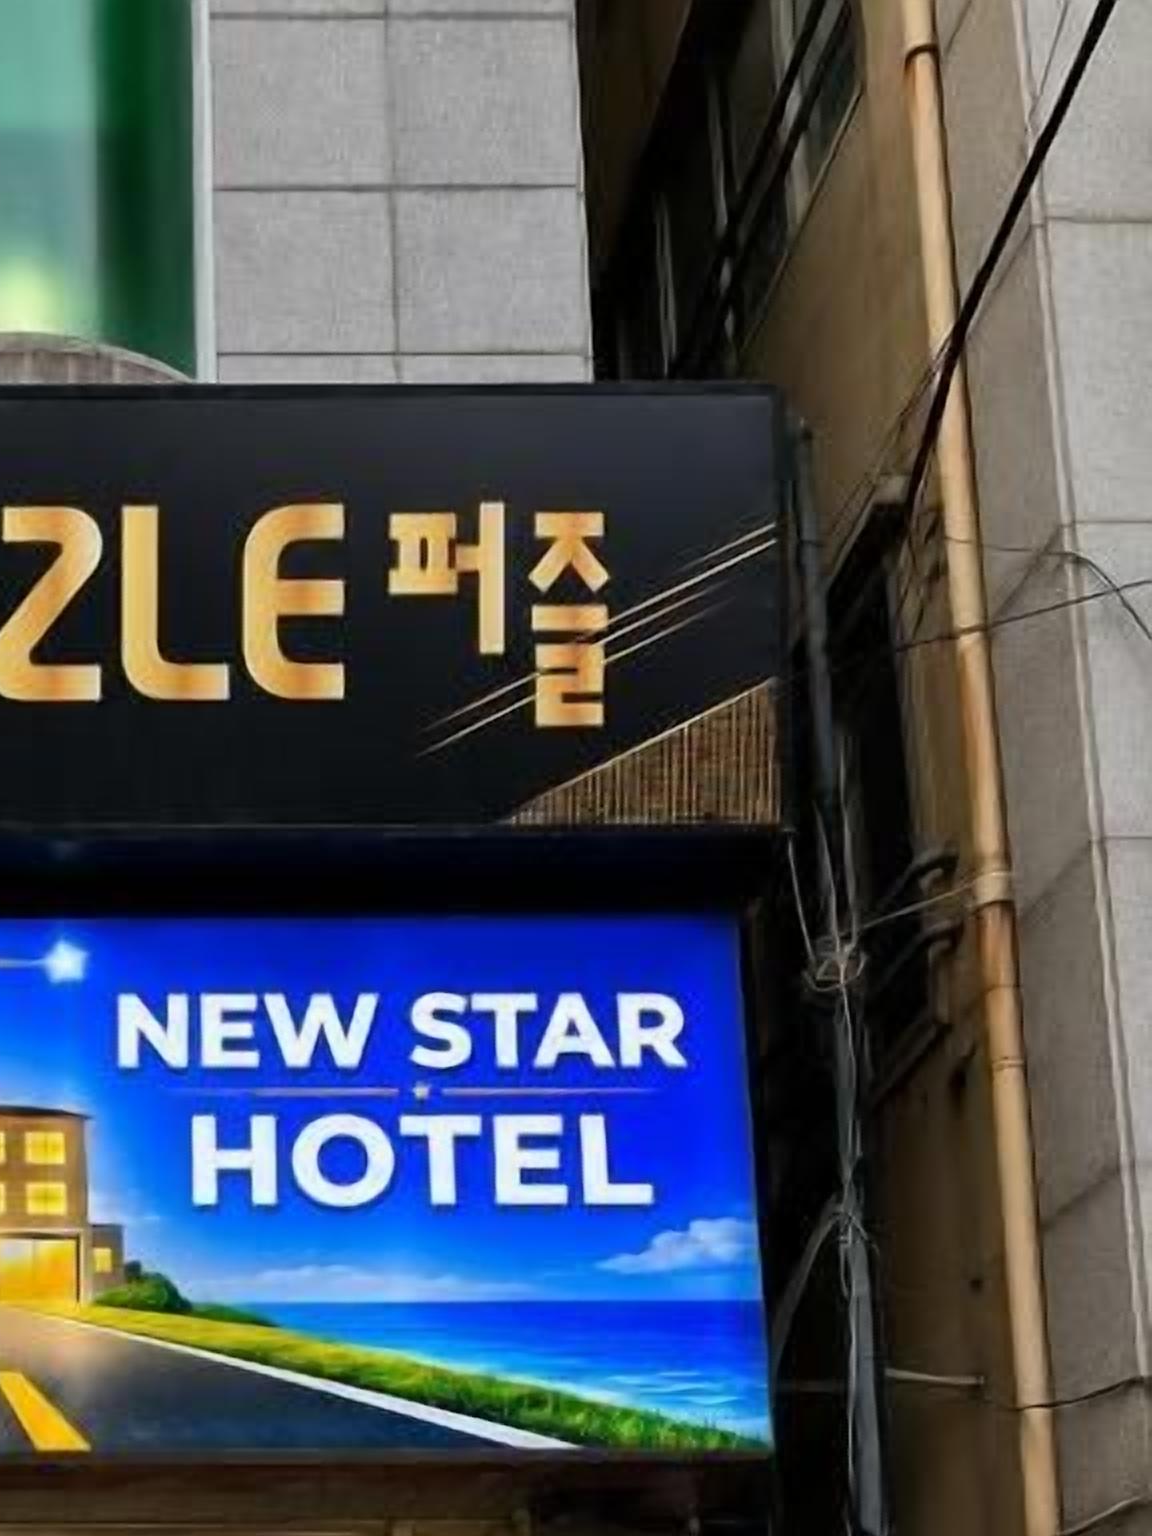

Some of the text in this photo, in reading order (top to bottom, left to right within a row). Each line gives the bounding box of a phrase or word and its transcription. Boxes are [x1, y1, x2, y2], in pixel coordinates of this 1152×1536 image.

[386, 500, 612, 728] 퍼즐
[115, 991, 688, 1070] NEW STAR
[190, 1113, 655, 1208] HOTEL
